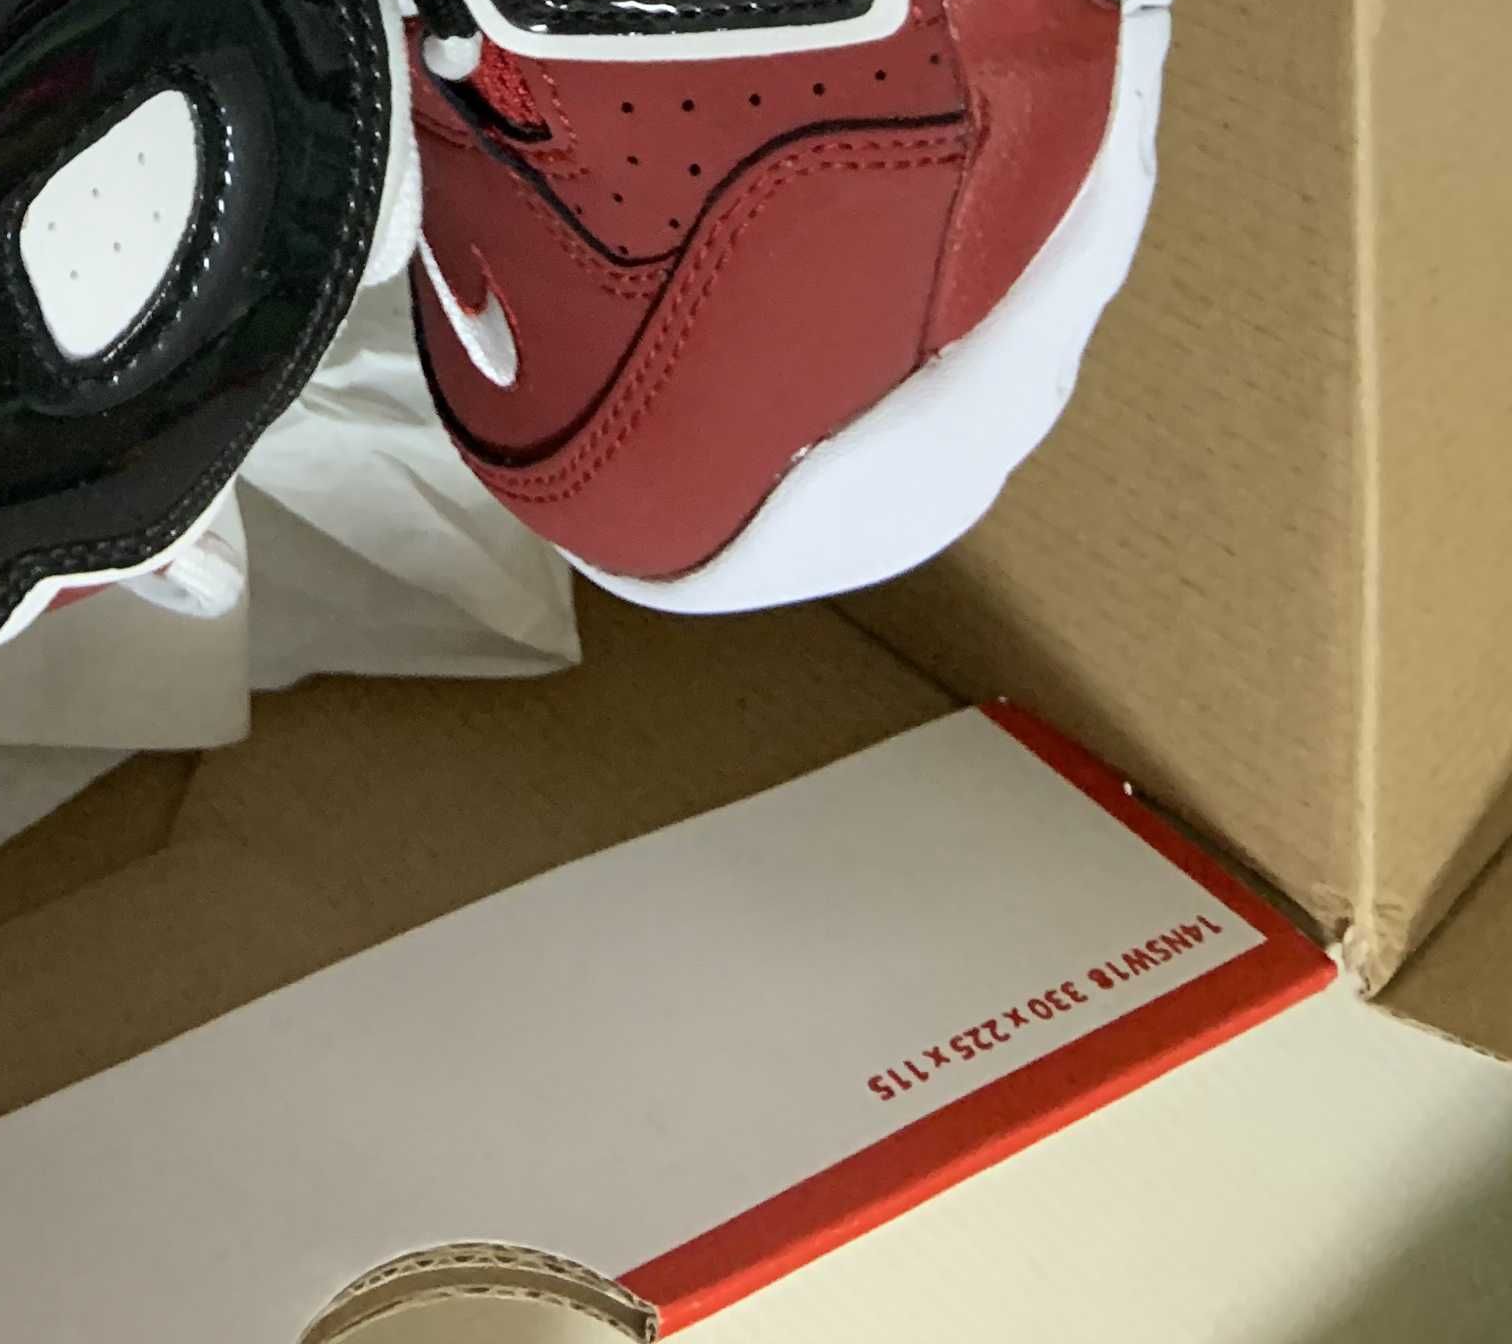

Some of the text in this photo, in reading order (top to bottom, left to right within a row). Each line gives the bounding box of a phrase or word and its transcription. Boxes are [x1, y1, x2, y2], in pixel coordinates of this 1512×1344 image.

[867, 914, 1223, 1101] 14NSW18 330 x 225 x 115
